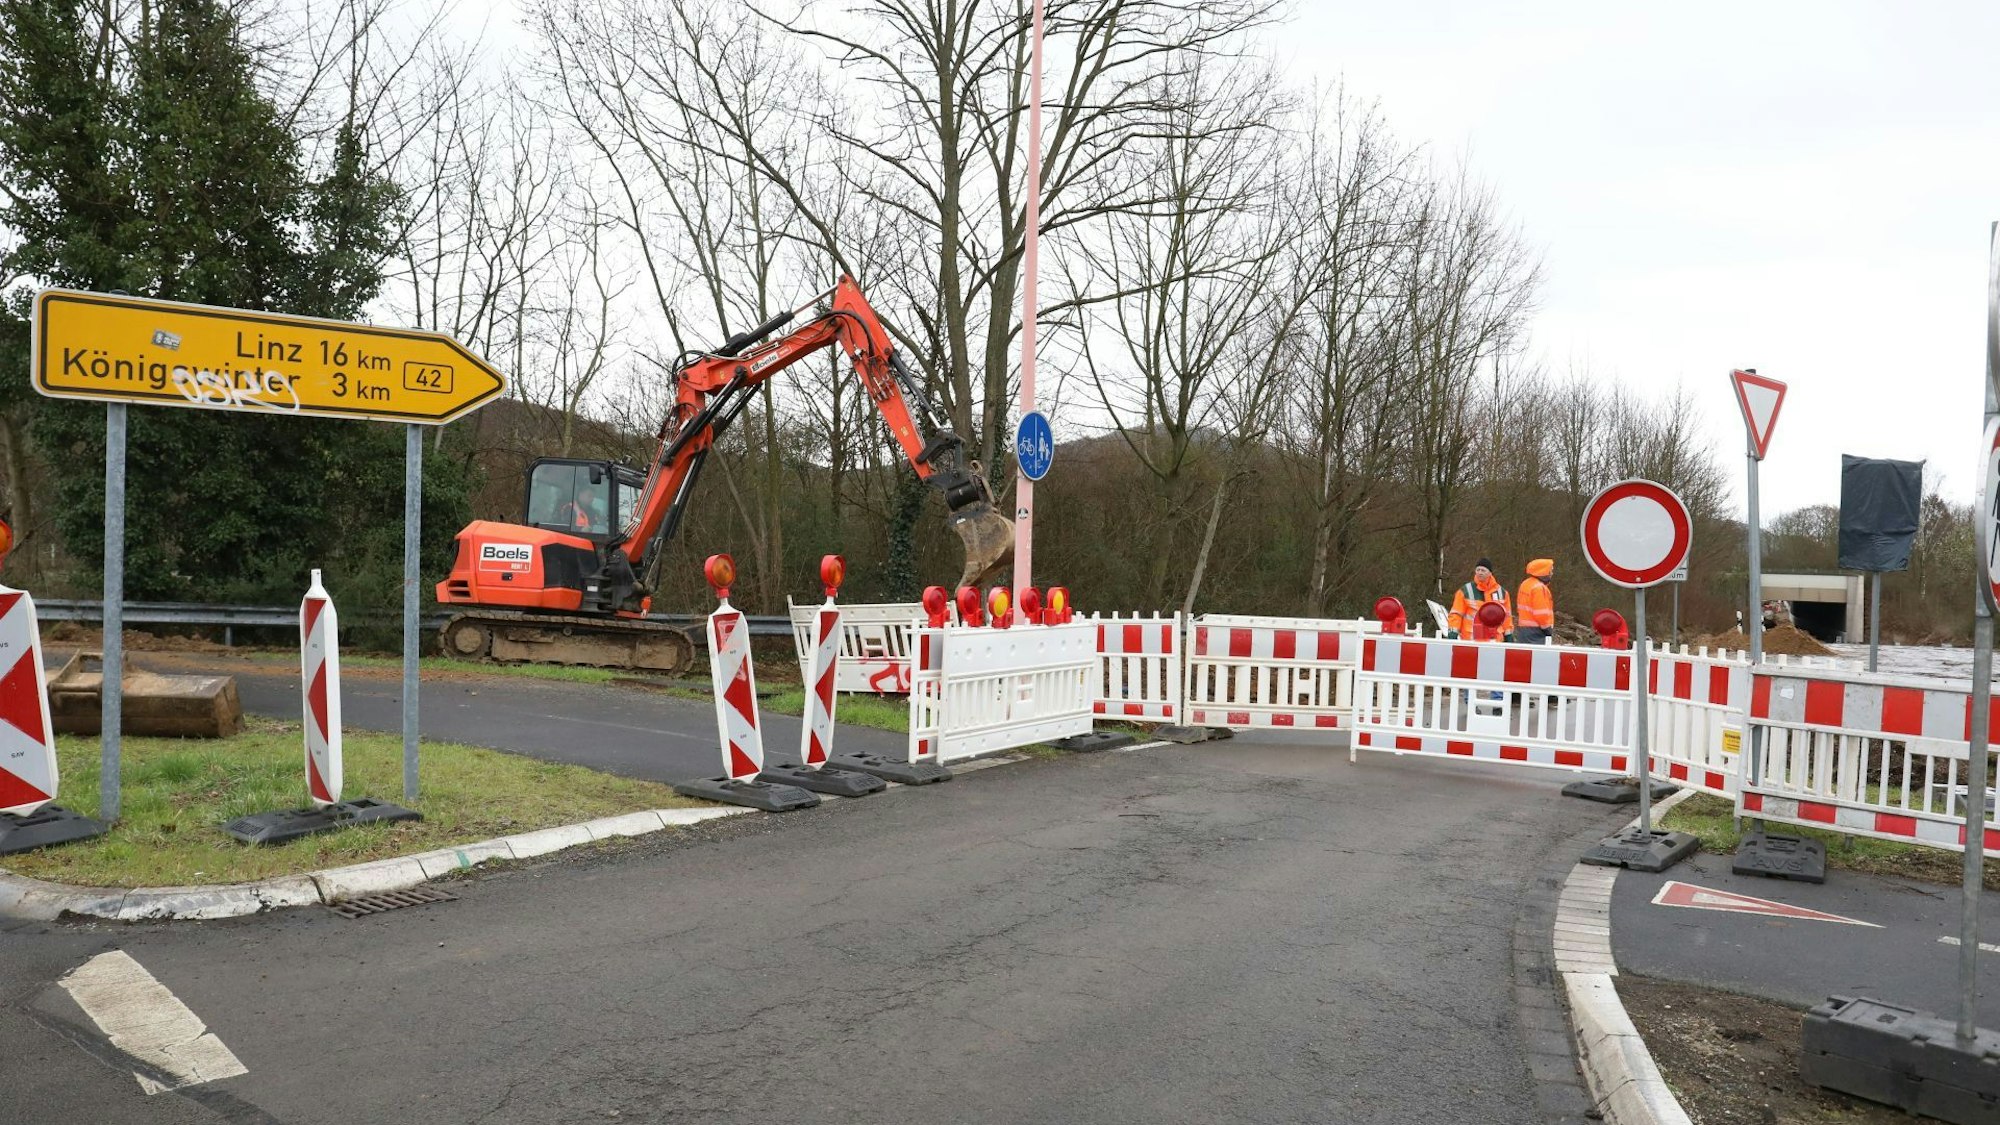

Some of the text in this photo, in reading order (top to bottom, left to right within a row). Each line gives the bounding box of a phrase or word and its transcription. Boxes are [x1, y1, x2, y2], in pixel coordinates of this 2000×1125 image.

[237, 331, 390, 371] Linz 16 km
[332, 372, 348, 397] 3
[357, 380, 390, 401] km
[416, 368, 441, 388] 42
[483, 546, 529, 560] Boels
